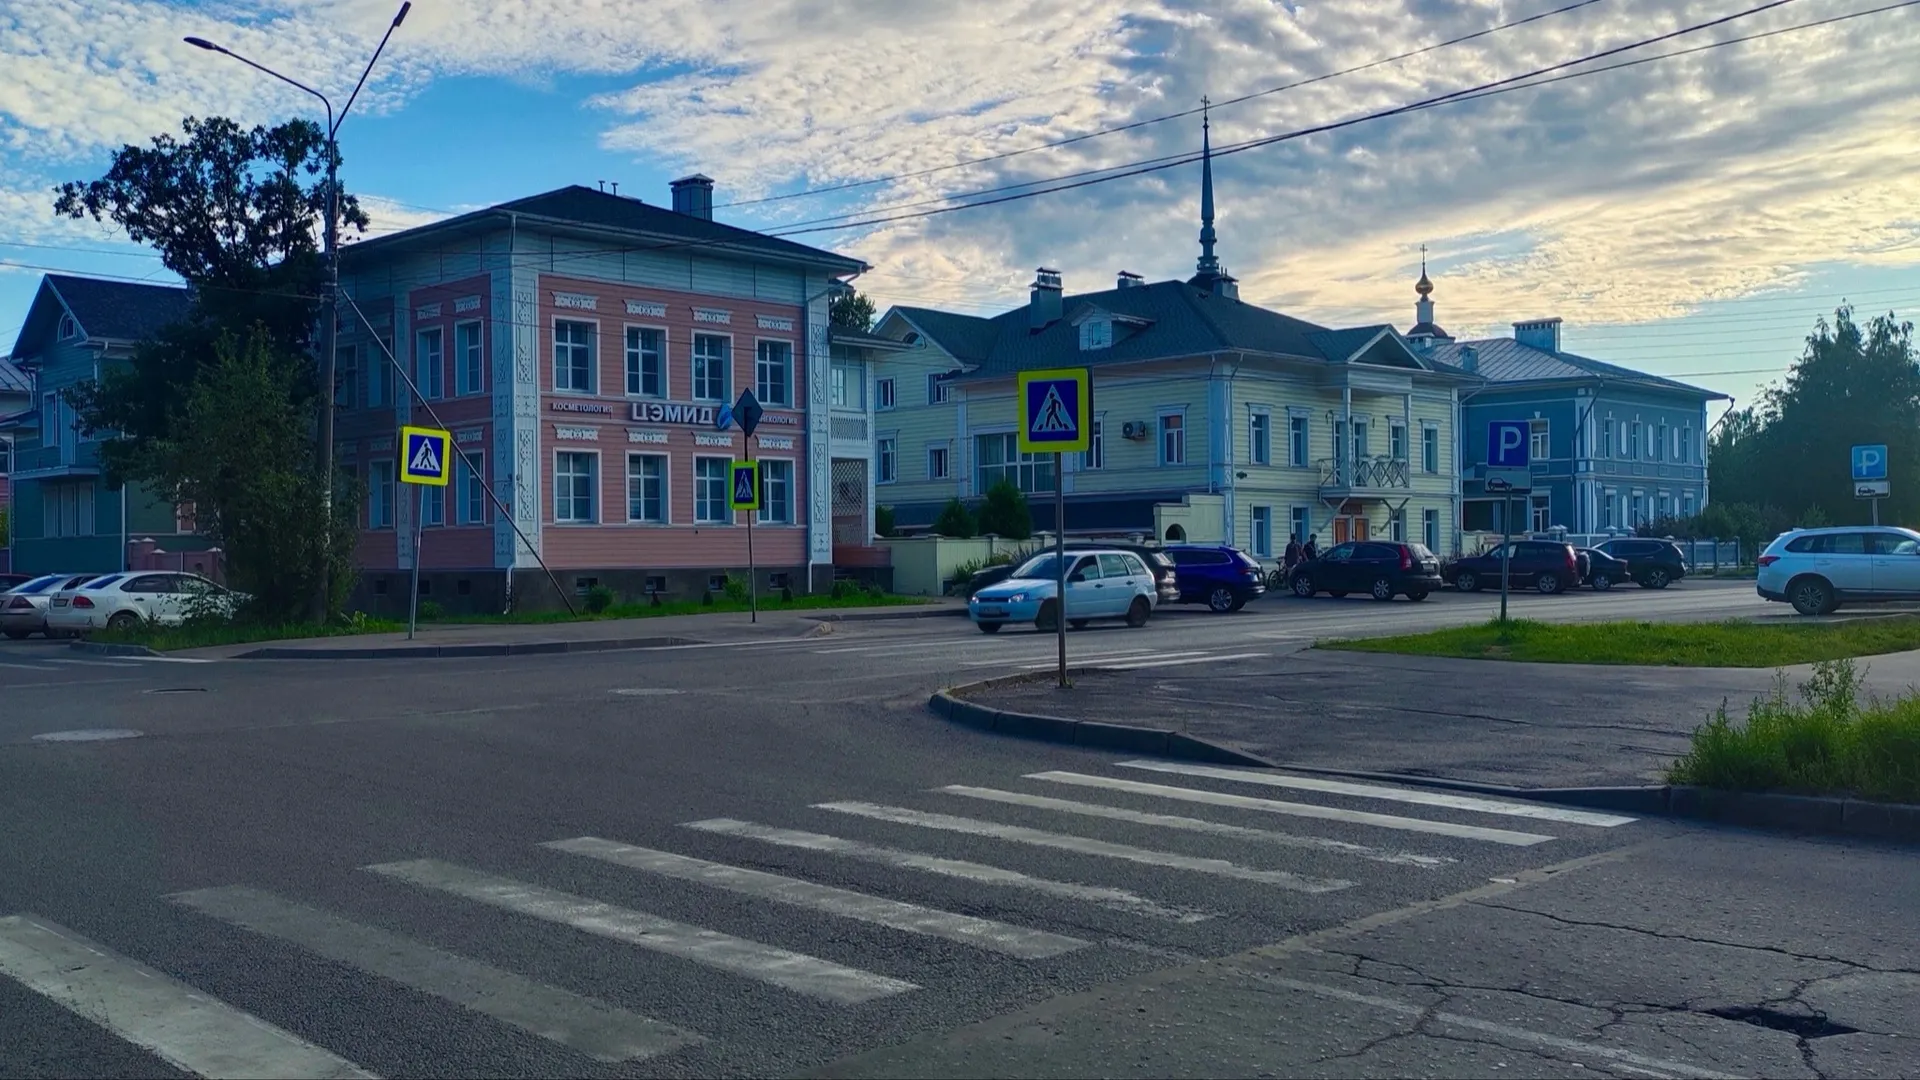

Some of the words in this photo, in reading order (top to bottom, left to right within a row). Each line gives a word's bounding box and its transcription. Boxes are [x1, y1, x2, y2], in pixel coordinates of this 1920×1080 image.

[552, 402, 613, 413] КОСМЕТОЛОГИЯ
[632, 402, 714, 425] ЦЭМИД
[759, 414, 798, 425] НЕКОЛОГИЯ
[1499, 426, 1522, 462] P
[1862, 450, 1880, 475] P
